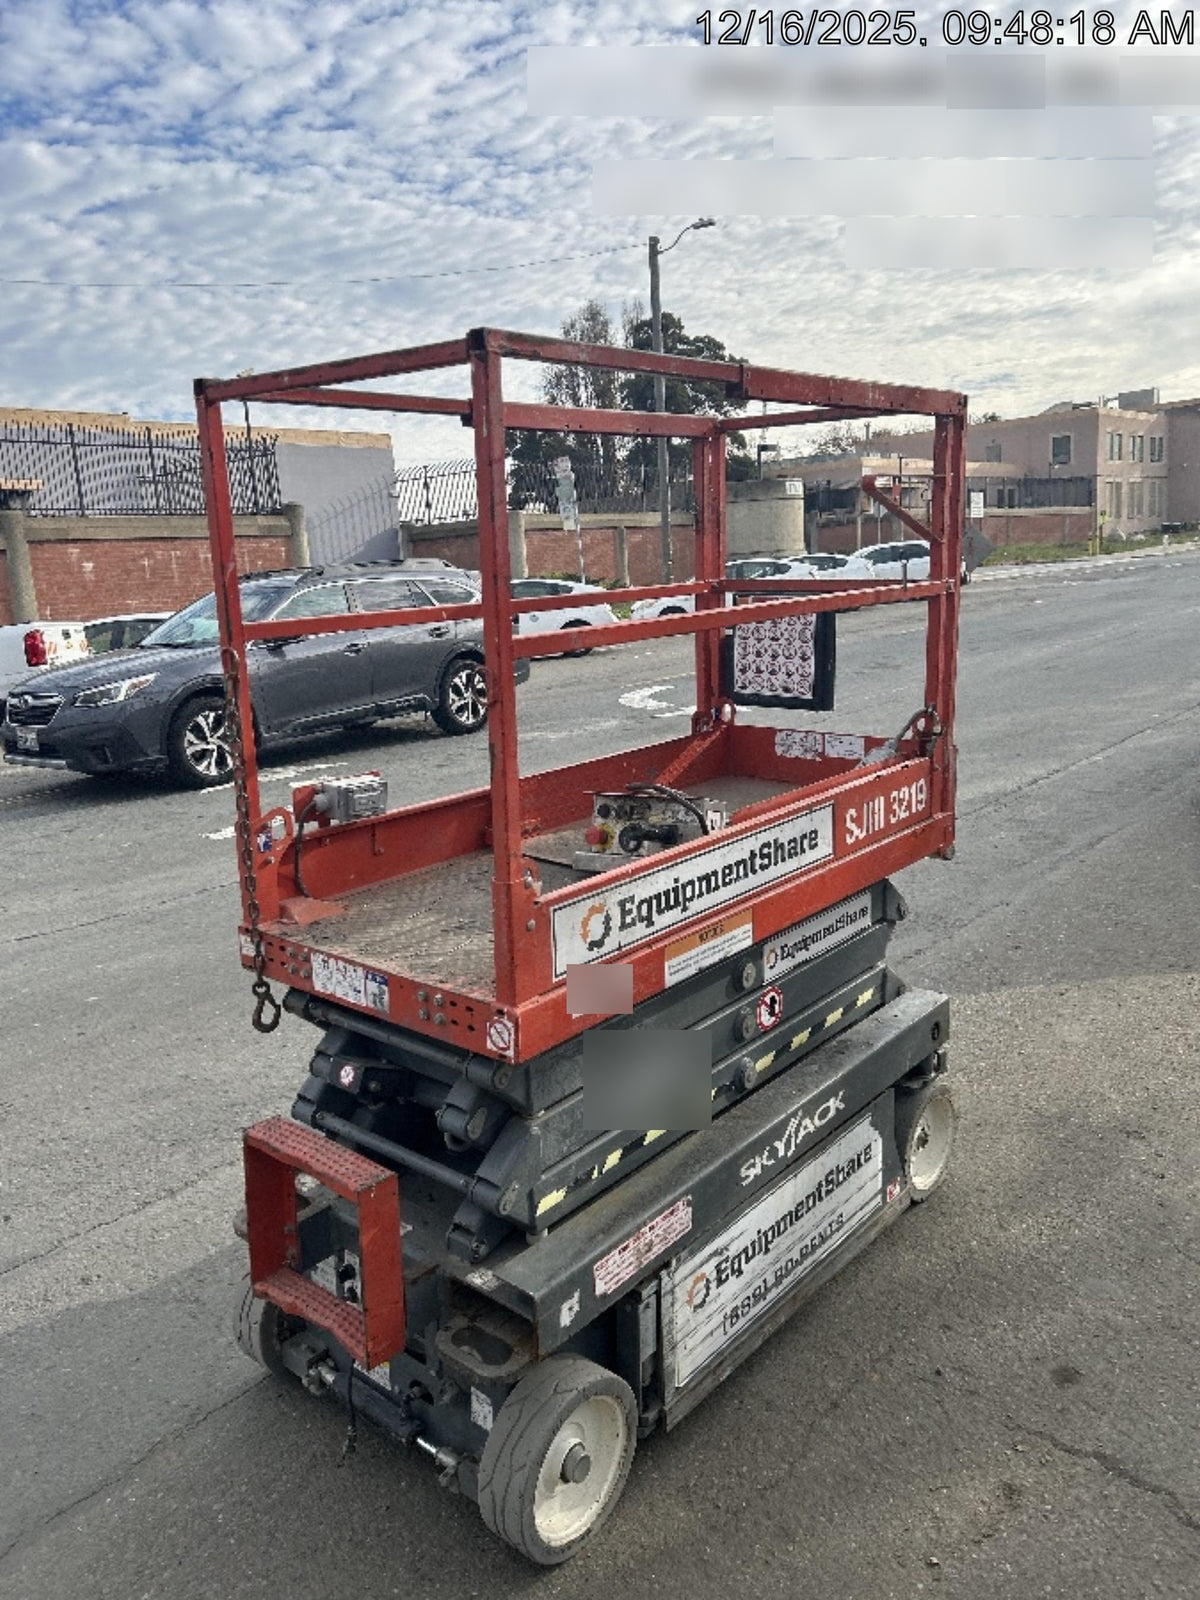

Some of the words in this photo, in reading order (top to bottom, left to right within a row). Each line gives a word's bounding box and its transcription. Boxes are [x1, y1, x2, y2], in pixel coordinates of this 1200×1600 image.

[889, 778, 926, 824] 3219
[617, 827, 819, 932] EquipmentShare
[779, 905, 869, 961] EquipmentShare
[739, 1089, 846, 1187] SKYJACK
[714, 1142, 872, 1289] EquipmentShare
